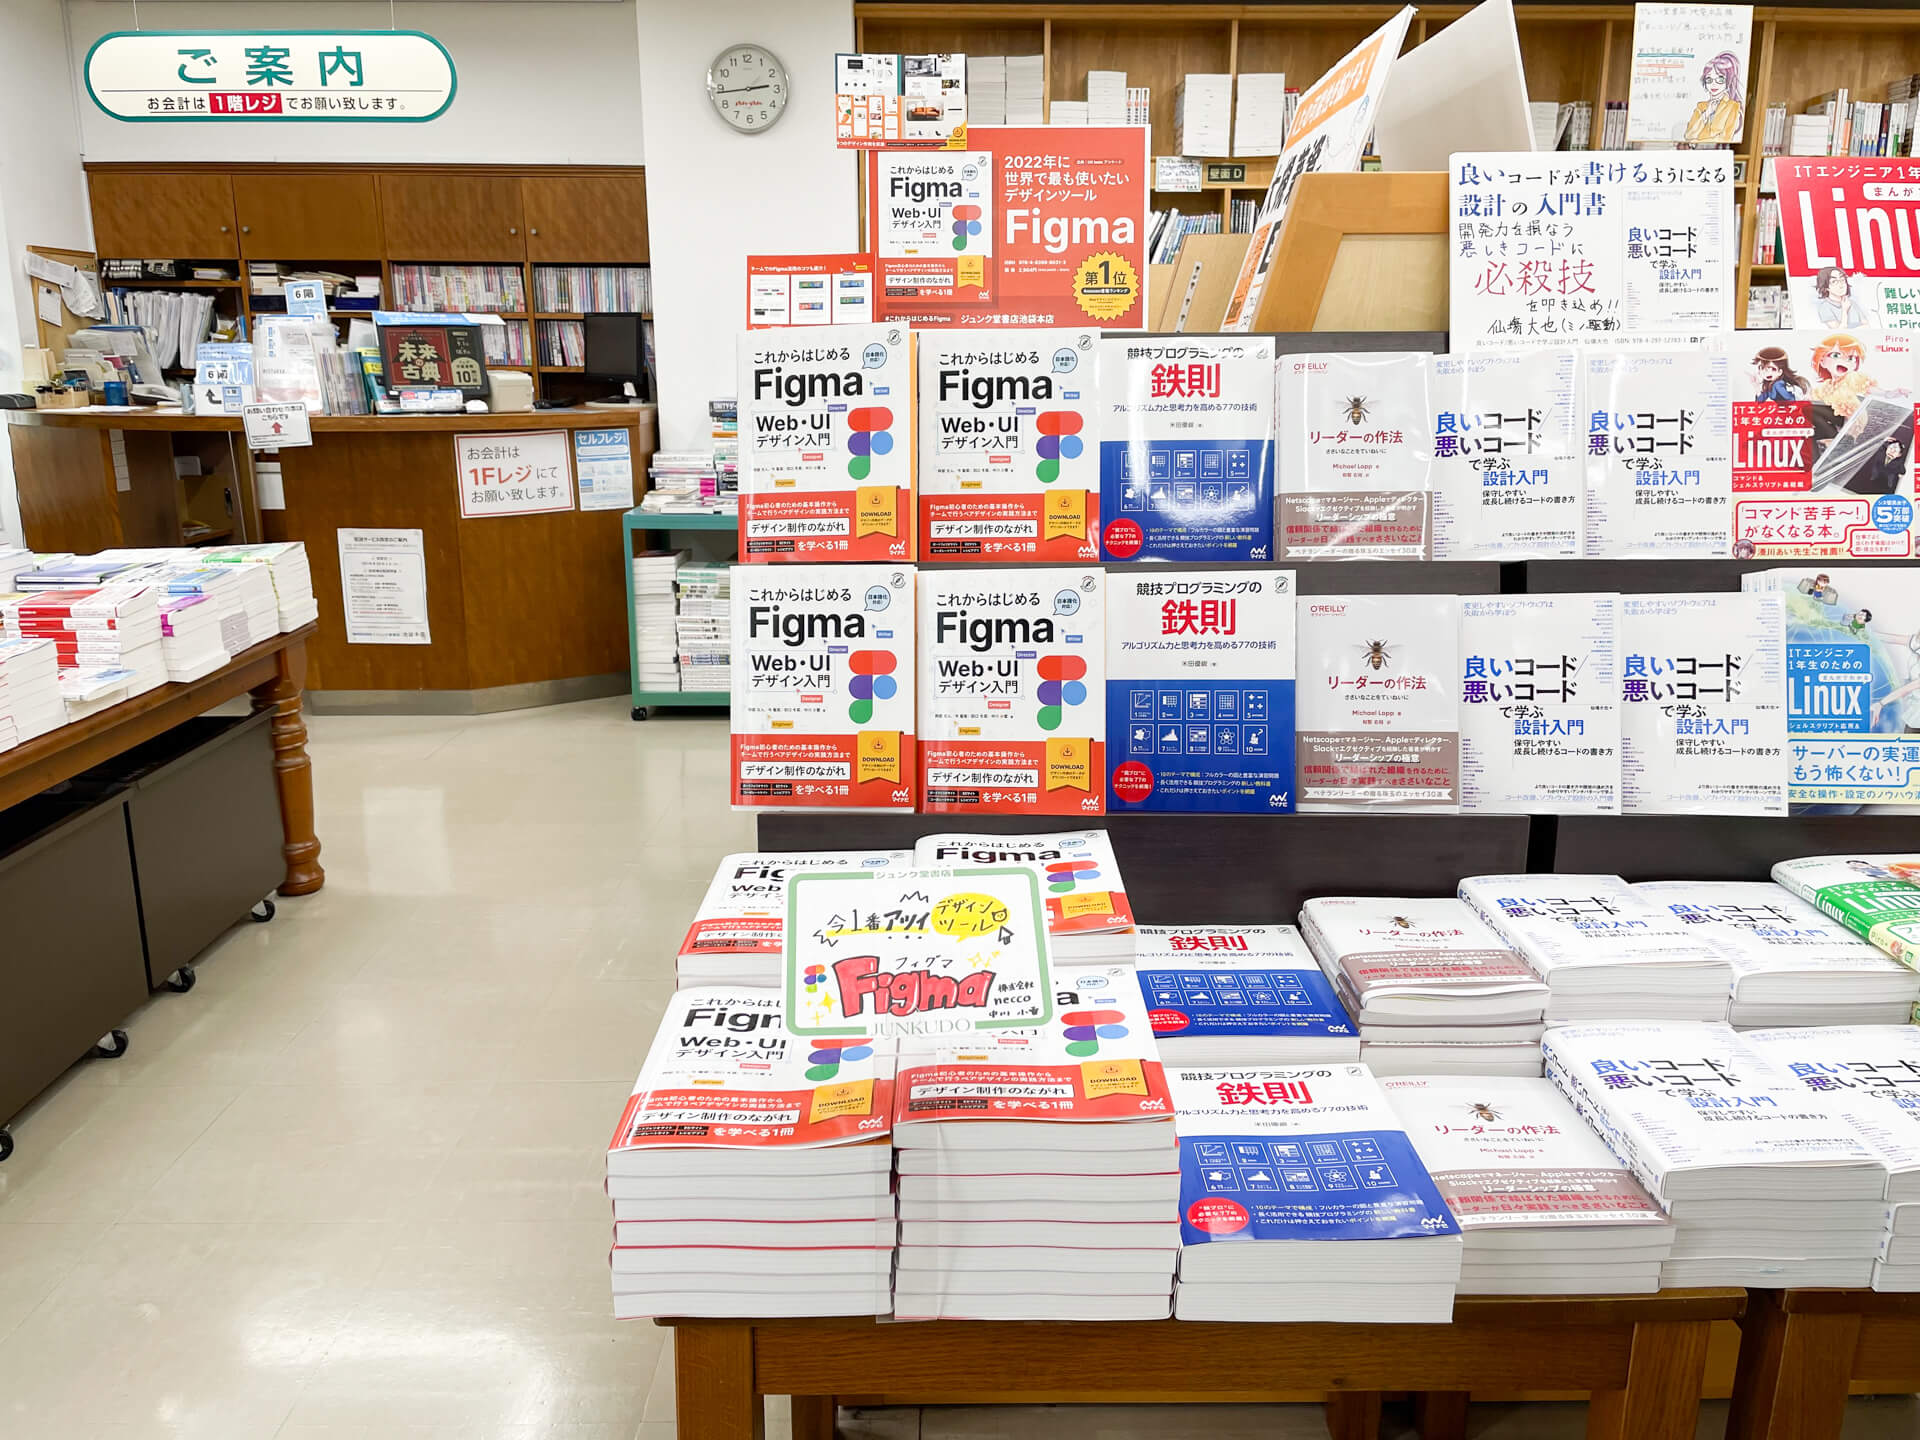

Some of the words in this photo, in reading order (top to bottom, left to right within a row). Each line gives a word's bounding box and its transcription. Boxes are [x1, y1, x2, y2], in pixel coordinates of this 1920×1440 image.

[730, 58, 737, 66] 11
[742, 54, 752, 64] 12
[760, 58, 763, 66] 1
[177, 46, 365, 87] ご案内
[720, 69, 729, 78] 10
[768, 69, 776, 78] 2
[773, 84, 780, 94] 3
[722, 100, 729, 109] 8
[769, 100, 776, 108] 4
[734, 111, 740, 119] 7
[746, 114, 753, 124] 6
[760, 111, 767, 120] 5
[1004, 155, 1070, 169] 2022年に
[890, 166, 954, 175] これからはじめる
[1459, 161, 1727, 186] 良いコードが書けるようになる
[1005, 171, 1130, 186] 世界で最も使いたい
[890, 178, 963, 202] Figma
[1005, 188, 1097, 202] デザインツール
[1874, 187, 1920, 196] まんが
[1459, 192, 1606, 217] 設計の入門書
[892, 220, 942, 229] デザイン入門
[1006, 208, 1135, 253] Figma
[1459, 221, 1574, 239] 開発力を損なう
[1459, 240, 1584, 258] 悪しきコードに
[1628, 243, 1697, 258] 悪いコード
[1475, 259, 1596, 296] 必殺技
[1659, 269, 1702, 280] 設計入門
[960, 315, 1055, 324] ジュンク堂書店池袋本店
[754, 348, 850, 364] これからはじめる
[939, 352, 1040, 365] これからはじめる
[753, 367, 863, 406] Figma
[1151, 363, 1221, 398] 鉄則
[939, 369, 1052, 408] Figma
[1734, 405, 1798, 414] ITエンジニア
[1734, 416, 1806, 426] 1年生のための
[756, 433, 831, 448] デザイン入門
[941, 436, 1018, 449] デザイン入門
[1310, 430, 1404, 444] リーダーの作法
[1434, 432, 1542, 457] 悪いコード
[1588, 433, 1694, 456] 悪いコード
[1733, 431, 1804, 468] Linux
[467, 447, 520, 461] お会計は
[1468, 458, 1511, 471] で学ぶ
[1622, 458, 1663, 471] で学ぶ
[1482, 470, 1548, 486] 設計入門
[1635, 470, 1700, 486] 設計入門
[1482, 496, 1575, 506] 成長し続けるコードの書き方
[1635, 496, 1727, 506] 成長し続けるコードの書き方
[751, 522, 846, 534] デザイン制作のながれ
[935, 524, 1033, 534] デザイン制作のながれ
[1745, 525, 1840, 539] がなくなる本。
[798, 540, 849, 551] を学べる1冊
[984, 542, 1036, 553] を学べる1冊
[749, 588, 852, 602] これからはじめる
[1136, 581, 1262, 595] 競技プログラミングの
[937, 593, 1040, 607] これからはじめる
[1161, 599, 1236, 635] 鉄則
[750, 605, 865, 647] Figma
[937, 610, 1054, 652] Figma
[1789, 649, 1854, 657] ITエンジニア
[1789, 660, 1863, 670] 1年生のための
[752, 675, 831, 688] デザイン入門
[939, 680, 1018, 694] デザイン入門
[1328, 676, 1427, 690] リーダーの作法
[1463, 680, 1577, 703] 悪いコード
[1623, 679, 1742, 702] 悪いコード
[1789, 675, 1863, 715] Linux
[1499, 706, 1544, 719] で学ぶ
[1660, 704, 1707, 718] で学ぶ
[1514, 719, 1584, 736] 設計入門
[1675, 718, 1749, 735] 設計入門
[1514, 747, 1614, 757] 成長し続けるコードの書き方
[746, 765, 846, 776] デザイン制作のながれ
[932, 772, 1034, 784] デザイン制作のながれ
[795, 785, 849, 795] を学べる1冊
[936, 848, 1061, 863] Figma
[935, 900, 993, 914] デザイン
[939, 918, 993, 932] ツール
[1168, 936, 1248, 951] 鉄則
[896, 955, 953, 970] フィグマ
[832, 955, 996, 1018] Figma
[994, 994, 1031, 1005] necco
[870, 1018, 970, 1036] JUNKUDO
[1603, 1073, 1741, 1090] 悪いコード
[1216, 1081, 1314, 1105] 鉄則
[1434, 1124, 1561, 1136] リーダーの作法
